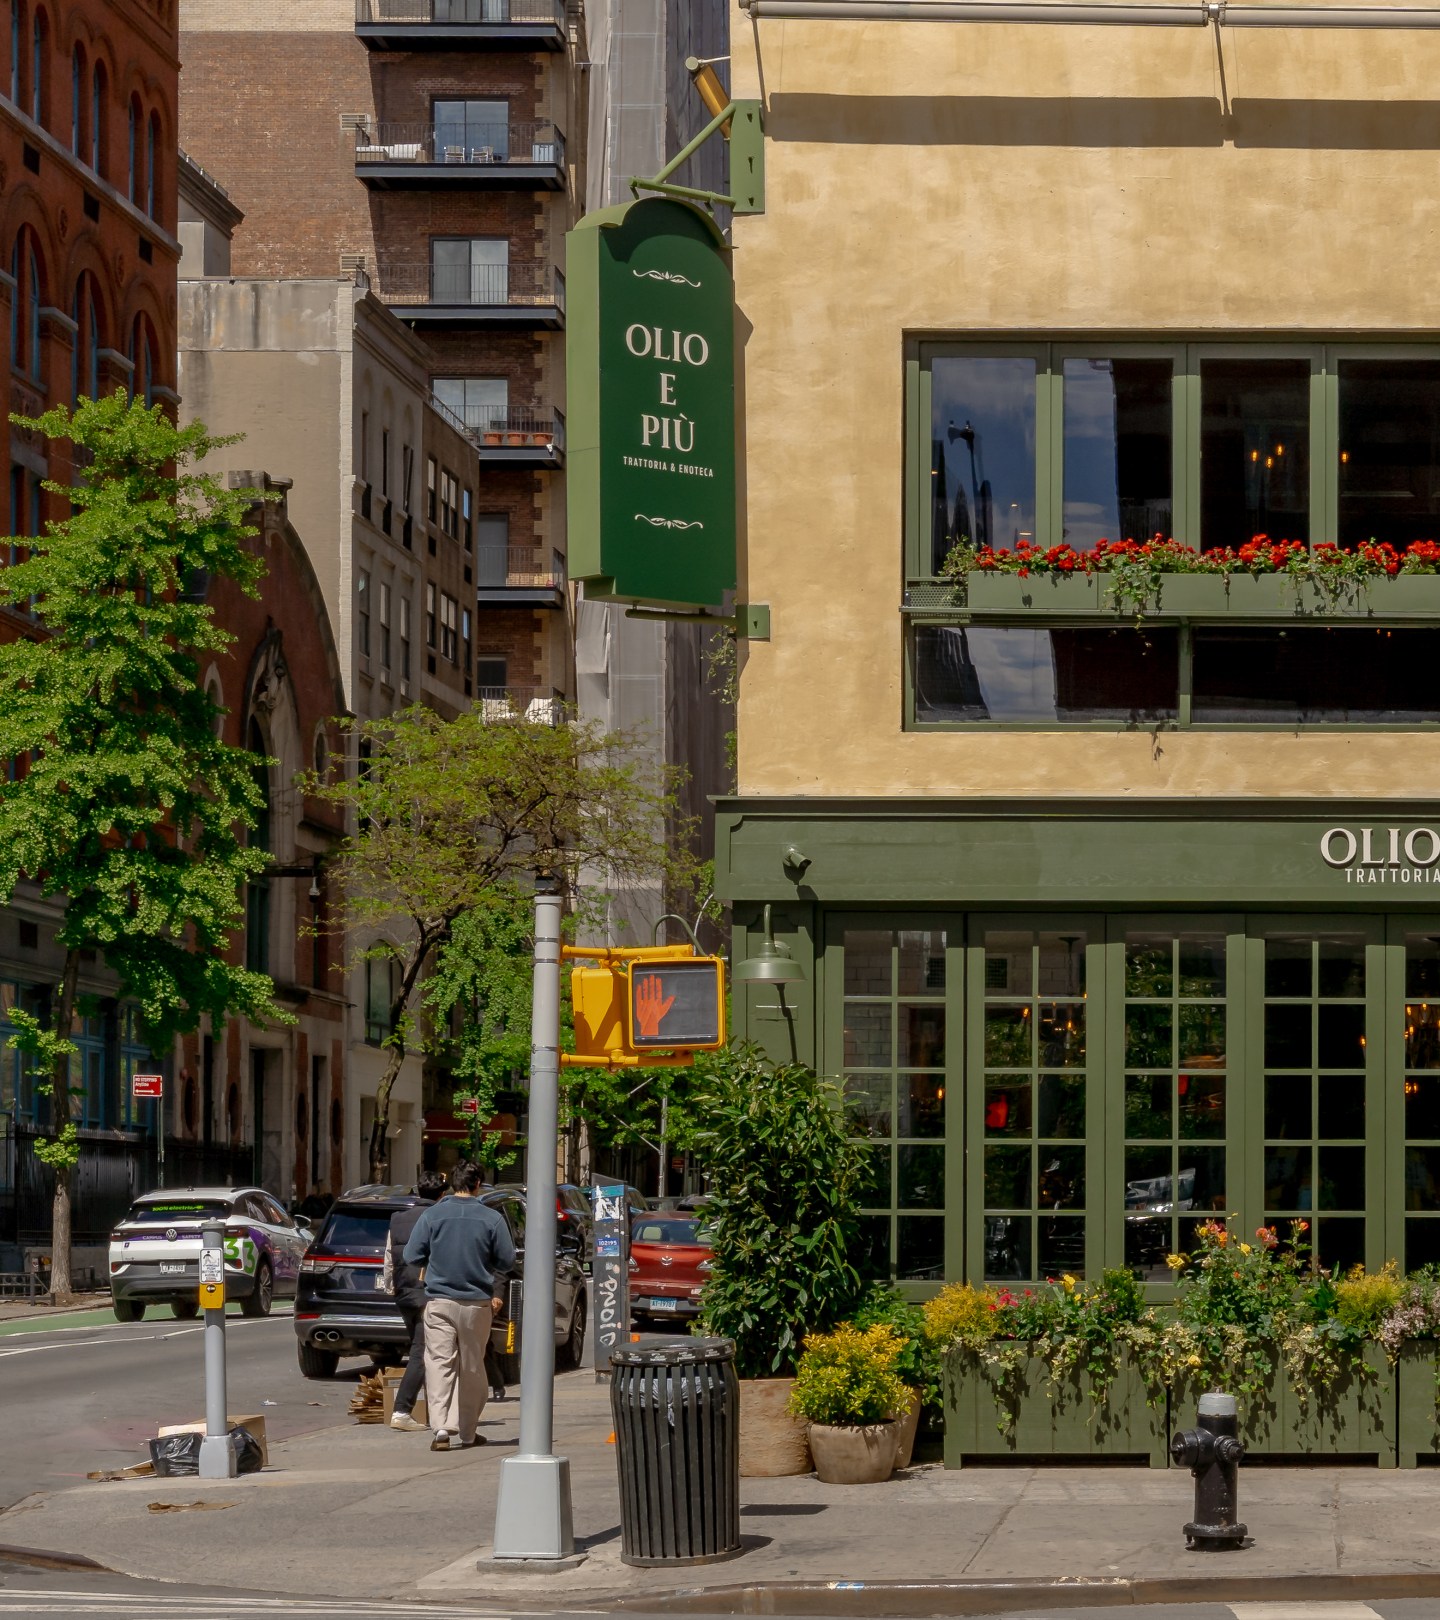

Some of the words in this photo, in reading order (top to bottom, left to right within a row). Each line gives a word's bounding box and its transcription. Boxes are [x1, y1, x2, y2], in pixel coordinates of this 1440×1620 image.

[625, 323, 709, 366] OLIO
[659, 372, 677, 406] E
[641, 412, 695, 452] PIÙ
[623, 456, 667, 471] TRATTORIA
[670, 463, 676, 472] &
[678, 463, 714, 478] ENOTECA
